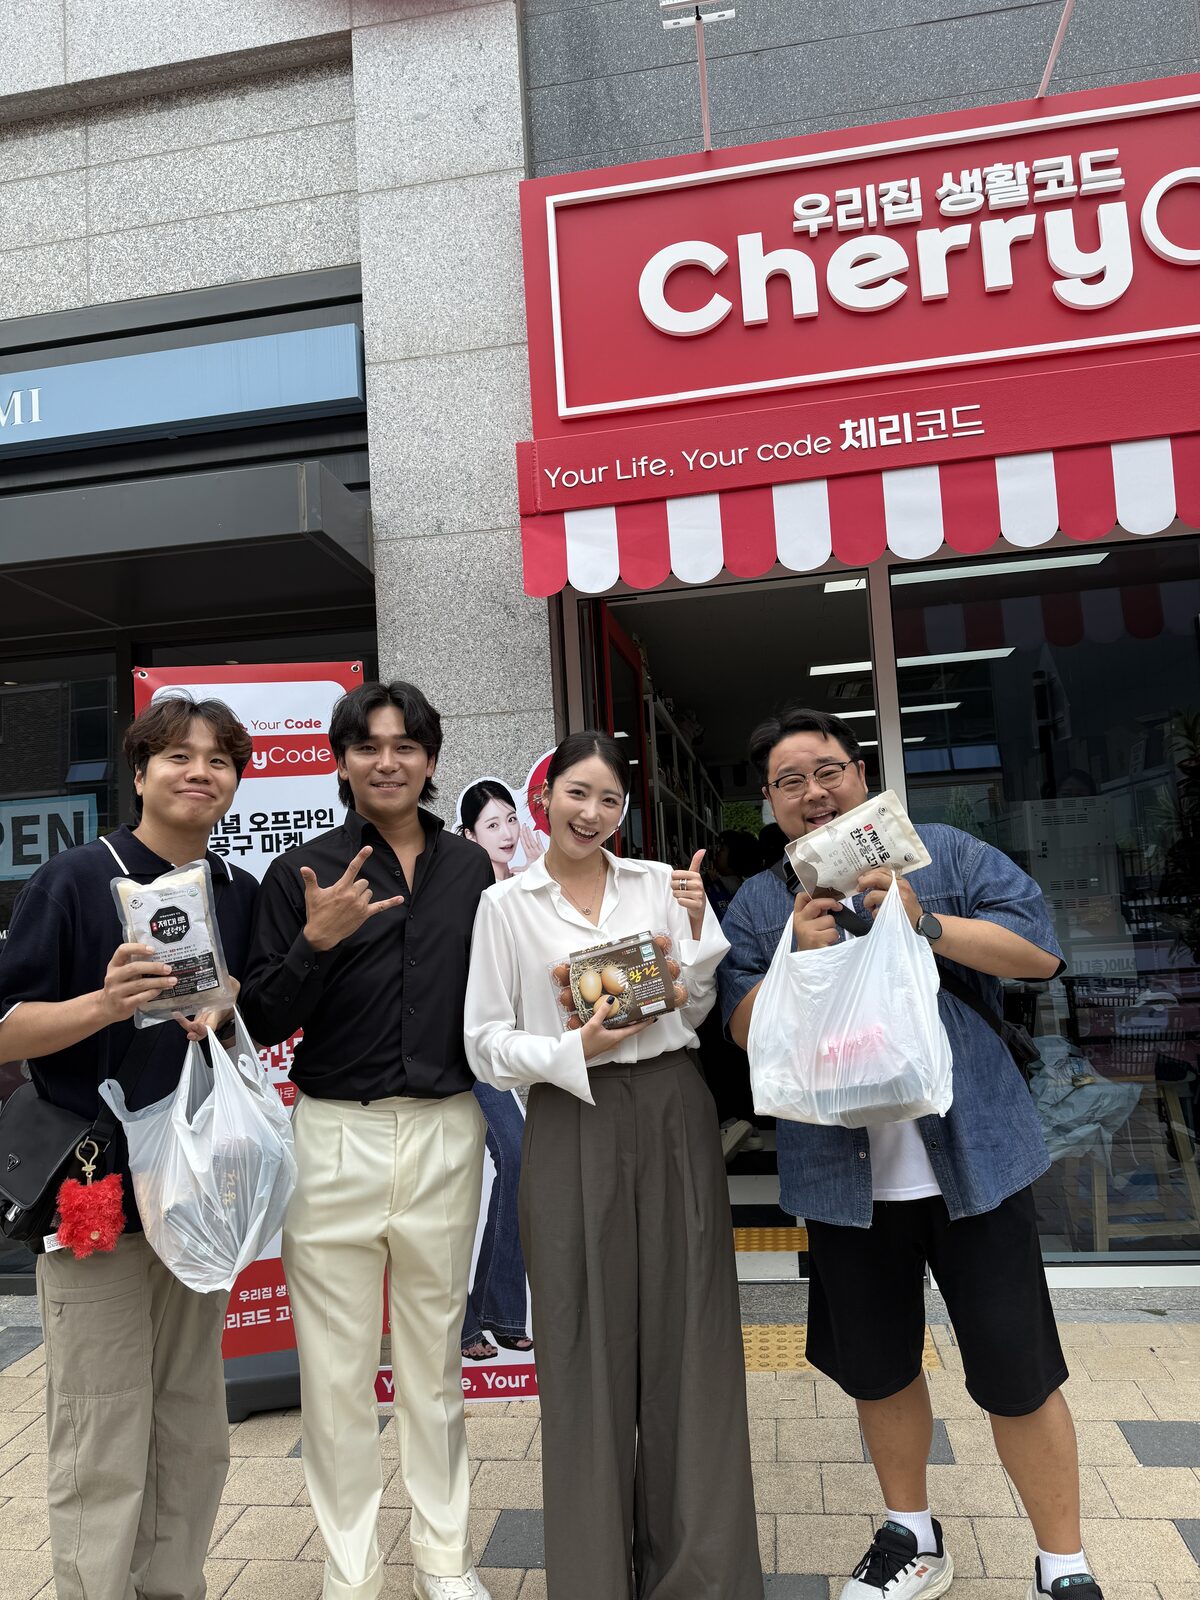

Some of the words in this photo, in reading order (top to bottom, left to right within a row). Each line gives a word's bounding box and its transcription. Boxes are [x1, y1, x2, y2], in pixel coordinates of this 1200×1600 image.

[793, 177, 922, 237] 우리집
[935, 148, 1125, 217] 생활코드
[544, 466, 608, 488] Your
[615, 456, 674, 480] Life,
[682, 447, 749, 471] Your
[756, 434, 832, 461] code
[839, 404, 985, 451] 체리코드
[251, 719, 281, 731] Your
[284, 718, 322, 729] Code
[249, 808, 335, 832] 오프라인
[0, 811, 84, 866] EN
[209, 835, 253, 856] 공구
[867, 830, 890, 863] 제대로
[239, 1286, 272, 1302] 우리집
[275, 1284, 290, 1297] 생
[223, 1308, 271, 1330] 리코드
[275, 1305, 293, 1322] 고
[482, 1372, 529, 1390] Your
